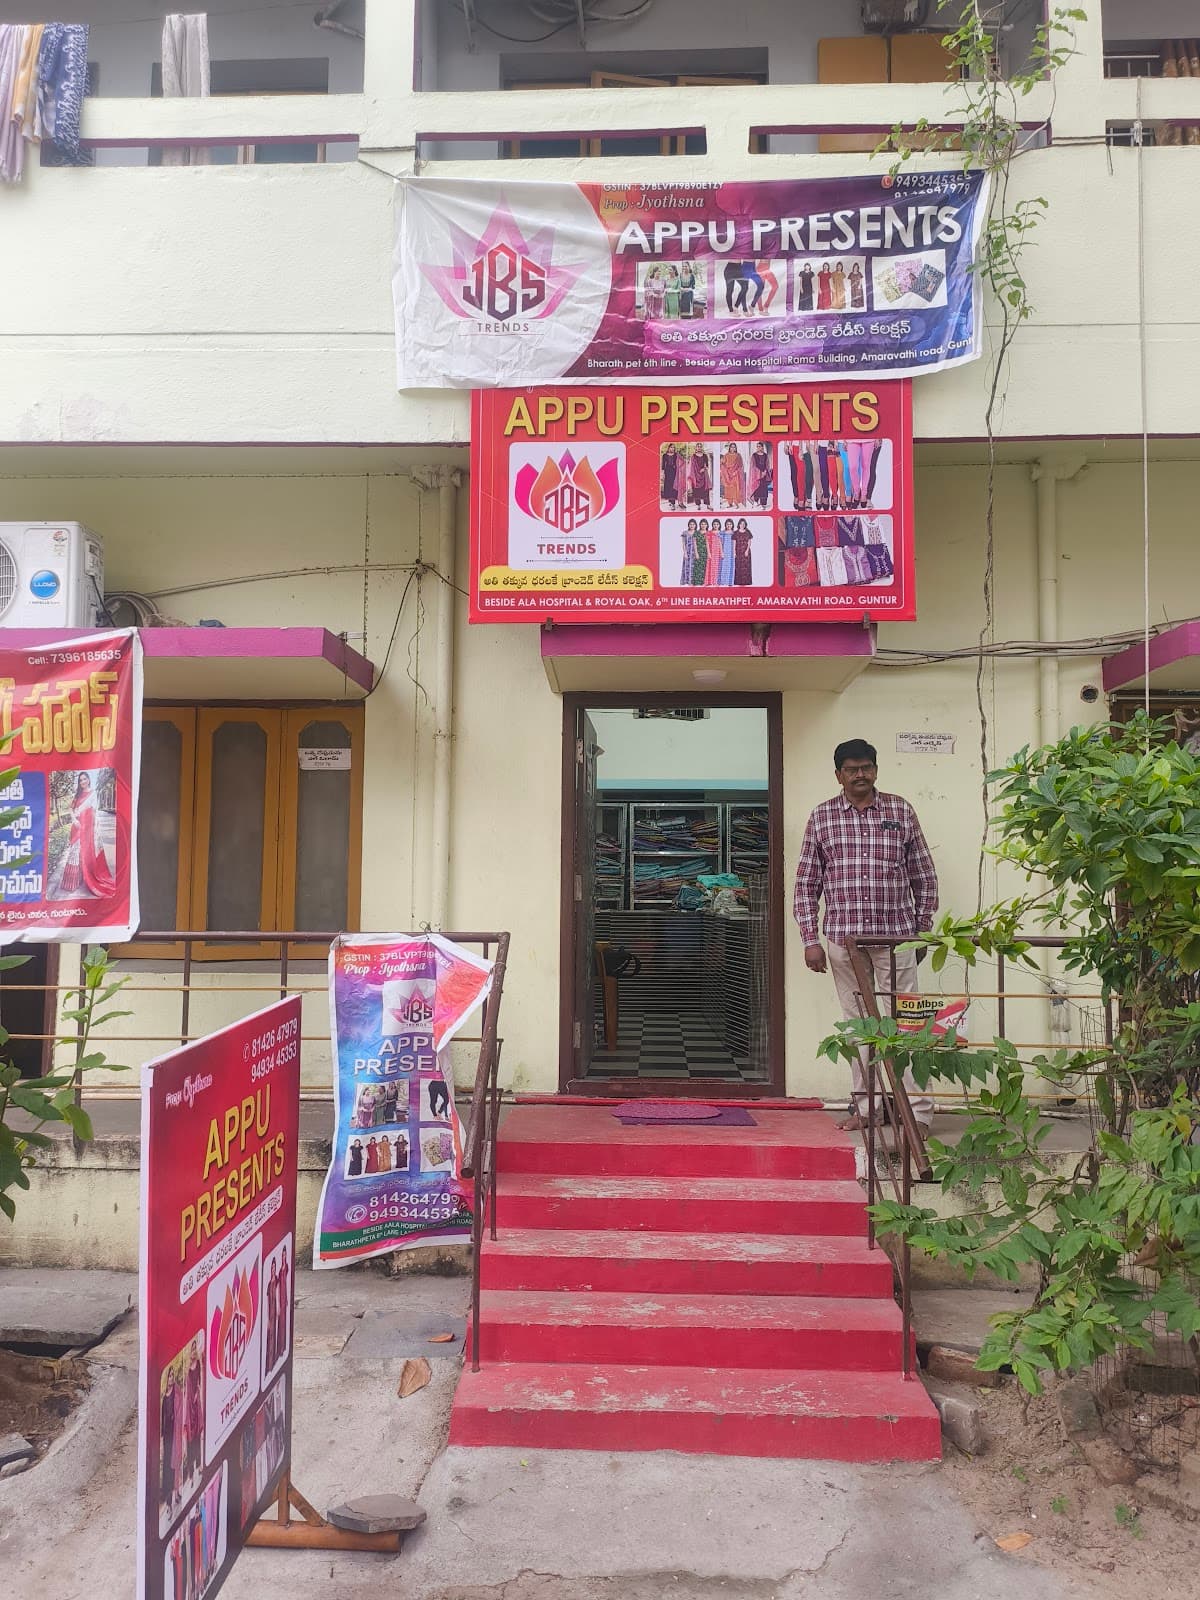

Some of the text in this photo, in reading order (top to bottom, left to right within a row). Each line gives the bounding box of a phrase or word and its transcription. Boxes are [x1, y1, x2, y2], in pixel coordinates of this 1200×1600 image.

[636, 193, 705, 212] Jyothsna
[615, 204, 963, 255] APPU PRESENTS
[463, 242, 546, 322] JBS
[477, 322, 530, 333] TRENDS
[660, 331, 683, 343] అతి
[587, 359, 623, 368] Bharath
[625, 359, 641, 369] pet
[643, 359, 658, 368] 6th
[660, 358, 678, 367] line
[685, 358, 716, 367] Beside
[787, 356, 815, 365] Rama
[818, 353, 858, 364] Building,
[861, 349, 918, 361] Amaravathi
[919, 345, 946, 357] road,
[503, 391, 879, 437] APPU PRESENTS
[544, 483, 590, 534] JBS
[536, 543, 597, 555] TRENDS
[483, 575, 499, 586] అతి
[502, 575, 528, 590] తక్కువ
[485, 598, 515, 607] BESIDE
[518, 598, 537, 607] ALA
[539, 597, 583, 607] HOSPITAL
[585, 598, 592, 606] &
[594, 597, 627, 607] ROYAL
[670, 597, 691, 606] LINE
[757, 596, 822, 606] AMARAVATHI
[858, 595, 897, 605] GUNTUR
[28, 650, 121, 666] Cell: 7396185635
[344, 953, 371, 962] GSTIN
[343, 961, 427, 977] Prop Jyothsna
[901, 1000, 944, 1009] 50 Mbps
[251, 1017, 298, 1058] 81426 47979
[251, 1040, 297, 1083] 94934 45353
[203, 1083, 272, 1181] APPU
[179, 1131, 286, 1262] PRESENTS
[362, 1225, 383, 1235] BESIDE
[220, 1378, 249, 1425] TRENDS
